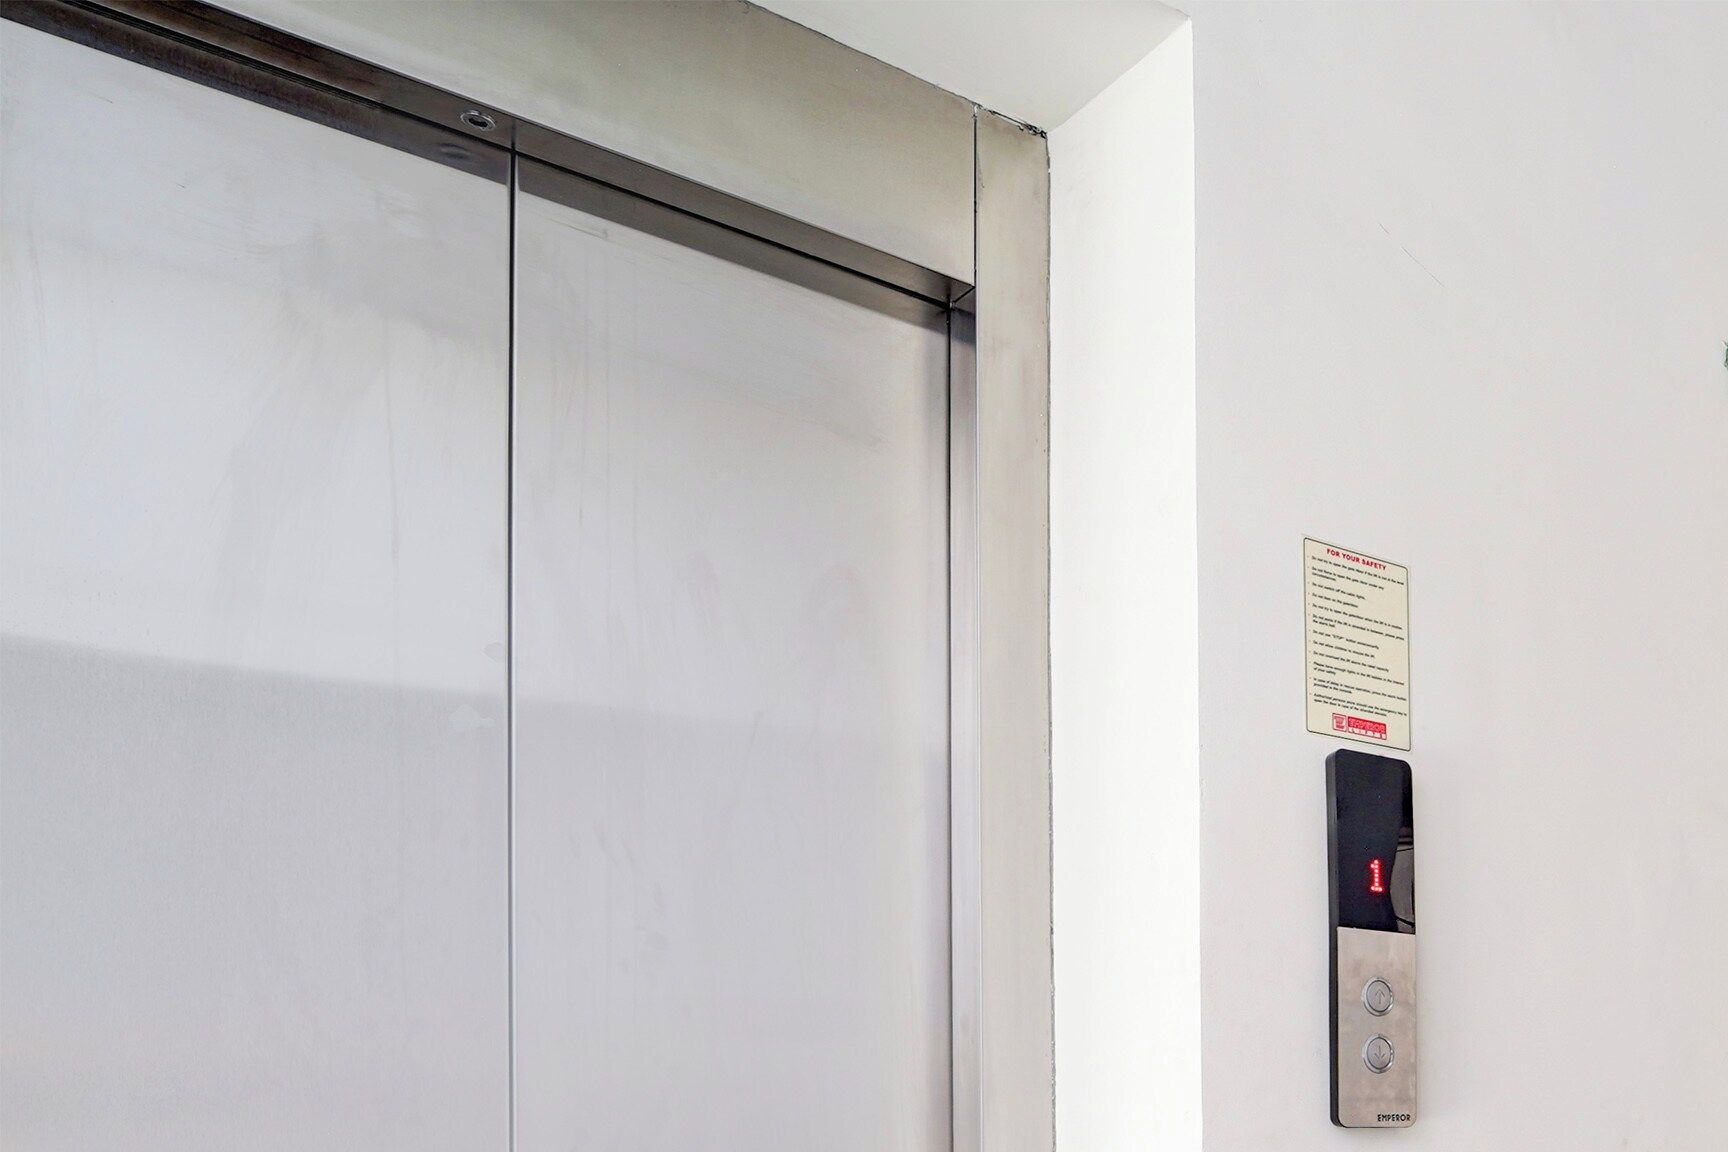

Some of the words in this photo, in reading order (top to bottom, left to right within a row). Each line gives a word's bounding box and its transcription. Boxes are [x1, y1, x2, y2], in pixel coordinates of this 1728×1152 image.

[1326, 548, 1340, 557] FOR
[1342, 552, 1360, 563] YOUR
[1361, 559, 1387, 570] SAFETY
[1370, 859, 1383, 892] 1
[1377, 1113, 1411, 1122] EMPEROR
